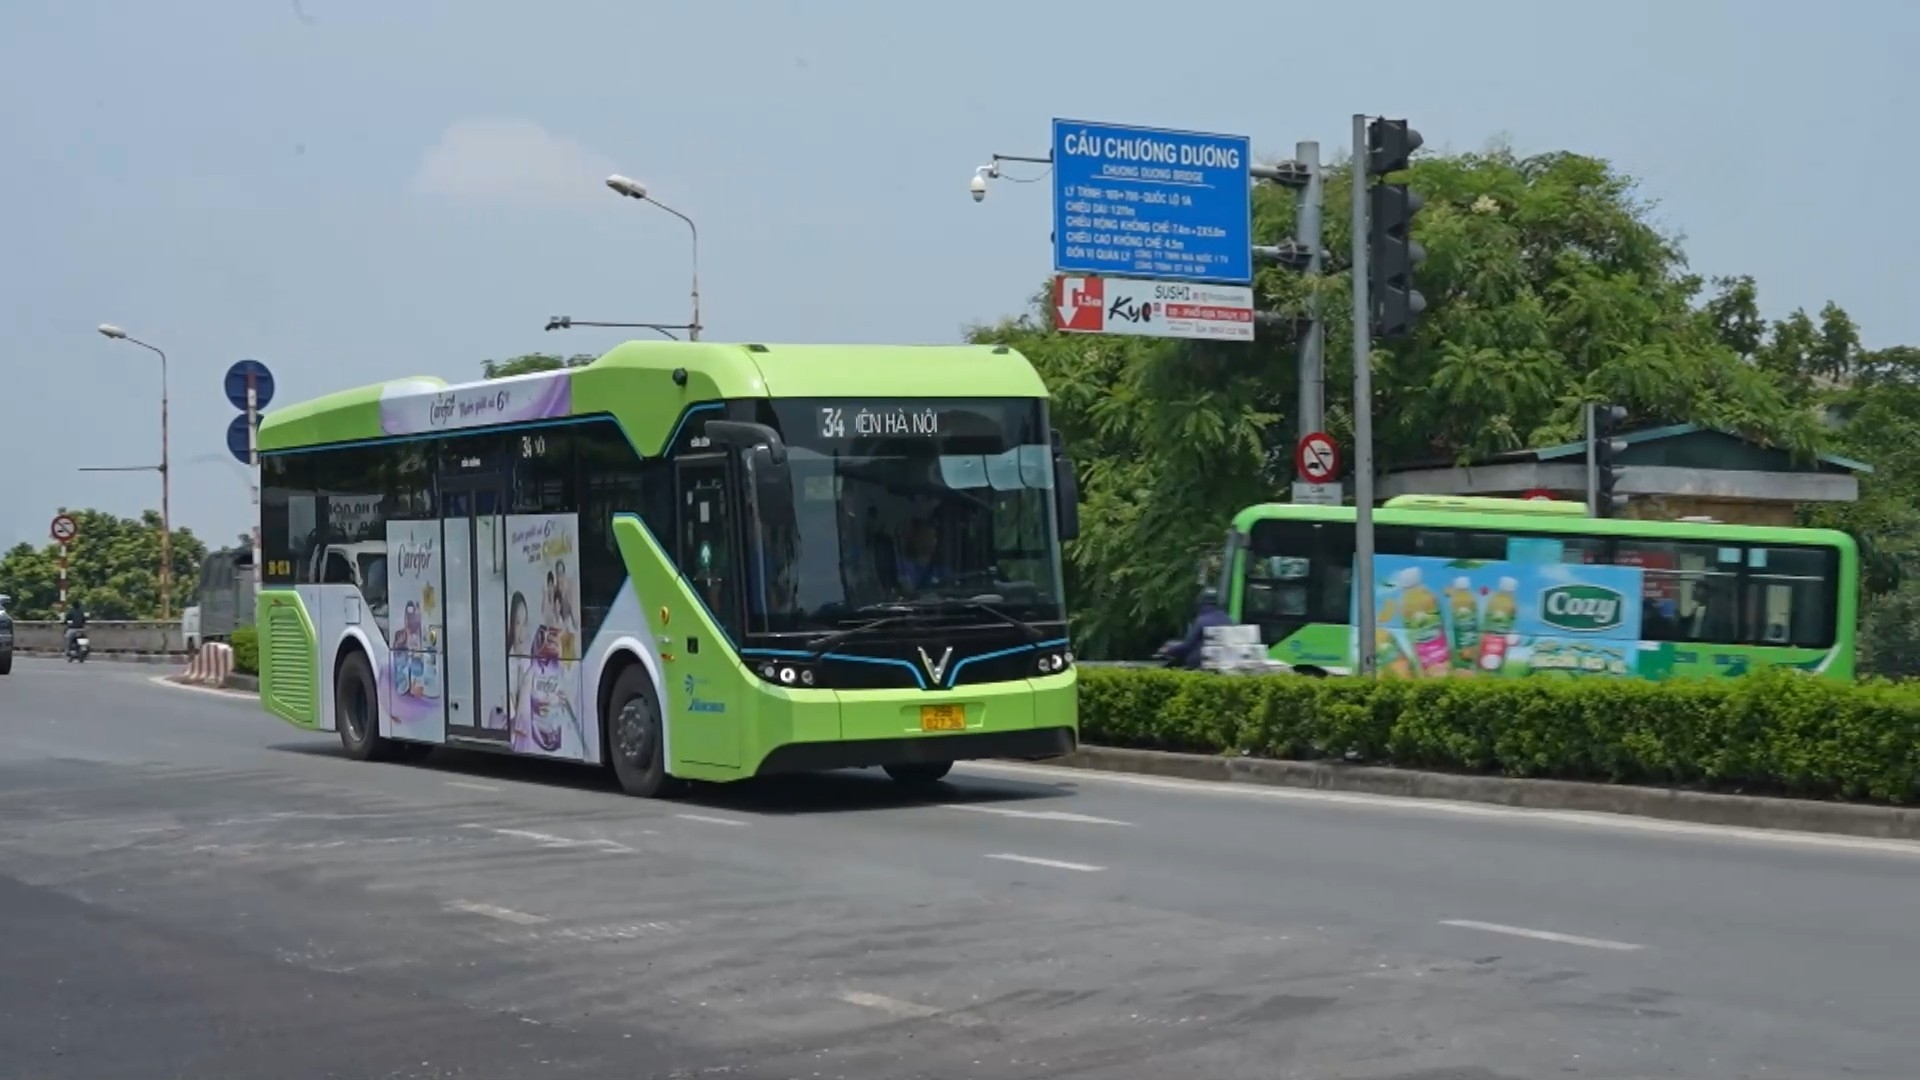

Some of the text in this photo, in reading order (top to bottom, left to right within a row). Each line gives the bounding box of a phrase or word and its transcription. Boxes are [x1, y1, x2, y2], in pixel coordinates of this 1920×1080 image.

[1155, 285, 1190, 300] SUSHI
[822, 407, 845, 437] 34
[886, 407, 908, 433] HÀ
[913, 407, 938, 437] NỘI
[522, 436, 532, 458] 34
[398, 537, 432, 579] Carefor
[1547, 591, 1620, 624] Cozy
